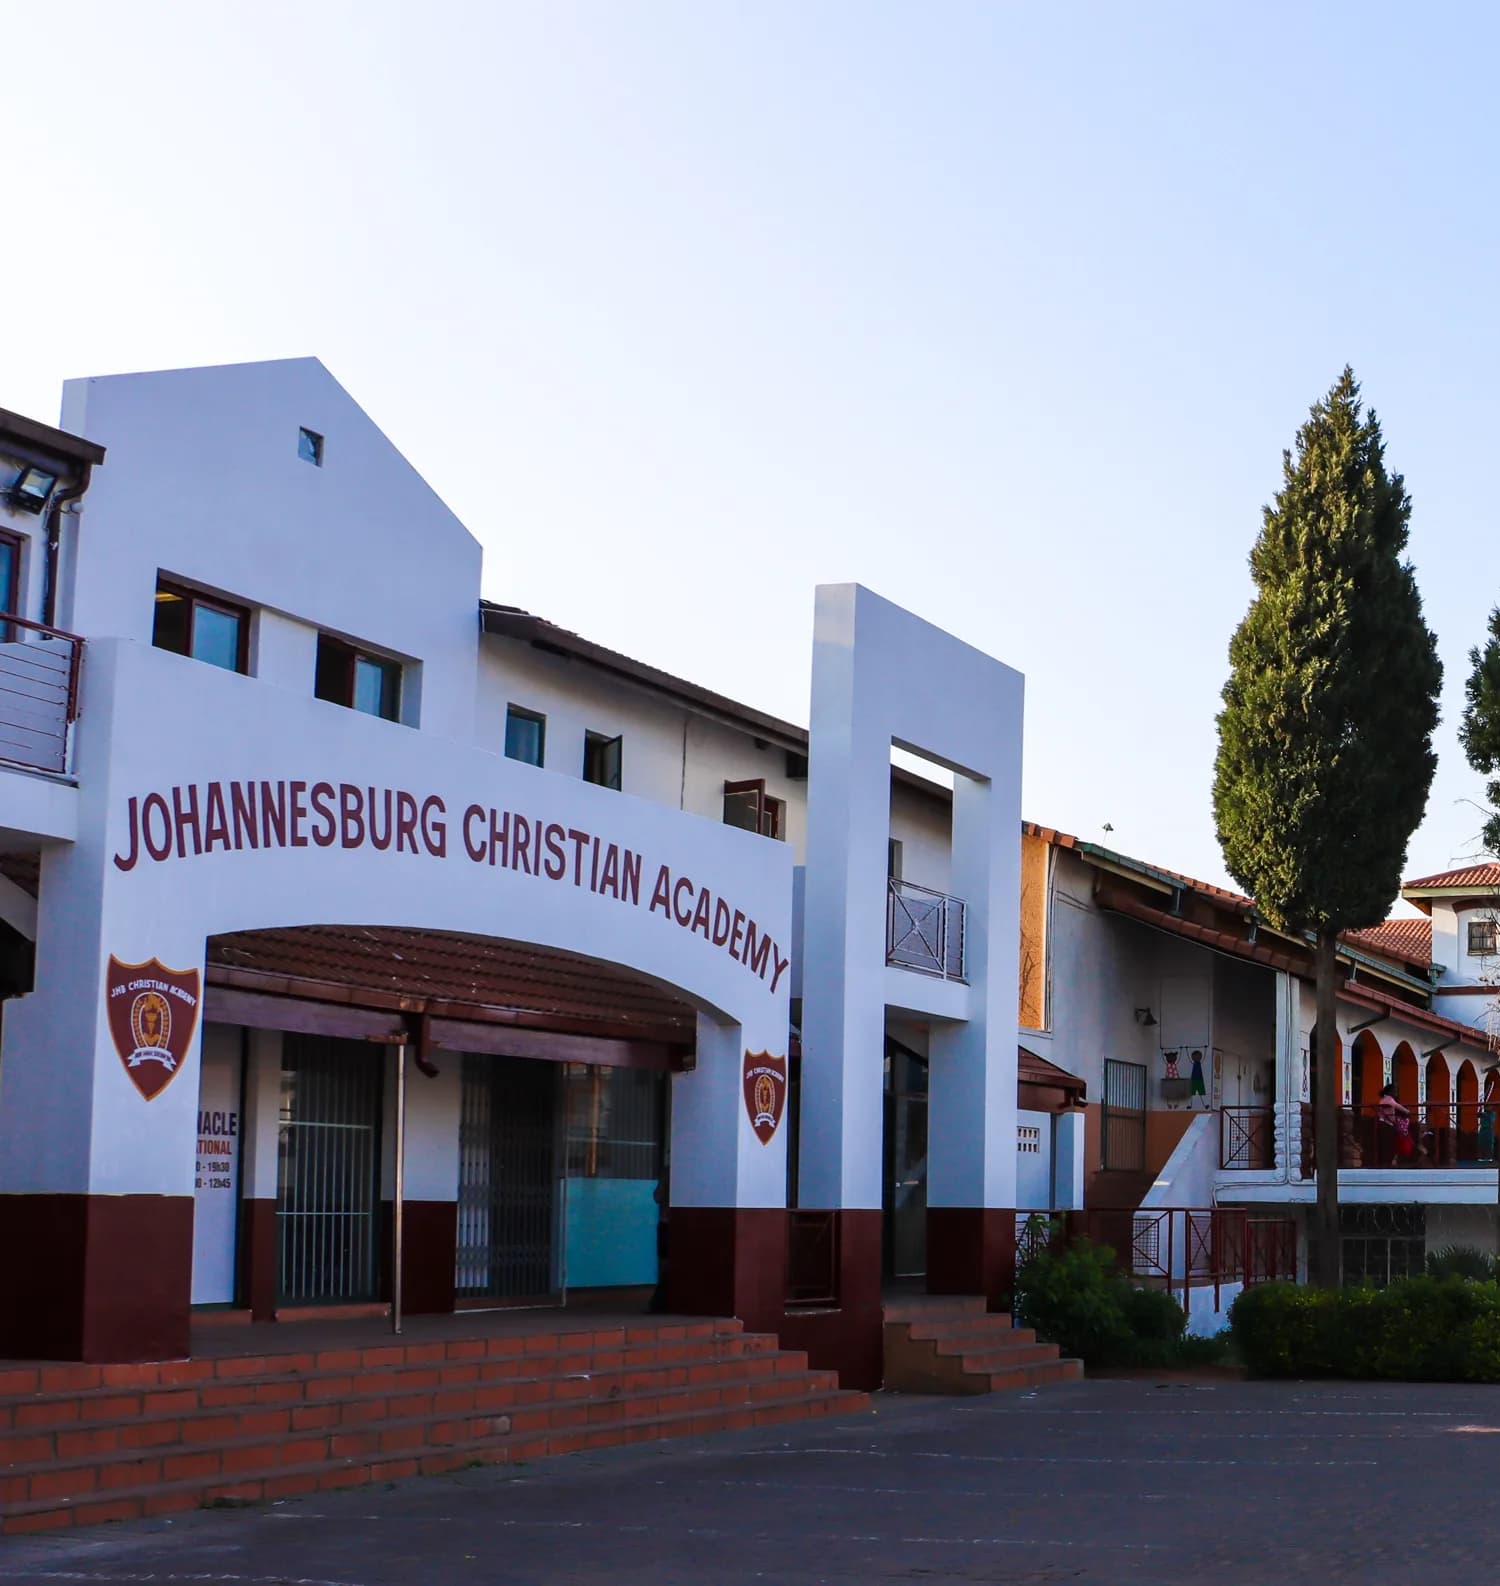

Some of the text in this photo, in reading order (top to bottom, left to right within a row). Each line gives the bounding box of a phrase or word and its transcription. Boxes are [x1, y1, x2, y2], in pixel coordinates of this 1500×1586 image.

[113, 780, 790, 995] JOHANNESBURG CHRISTIAN ACADEMY
[111, 984, 127, 998] JHB
[128, 979, 169, 993] CHRISTIAN
